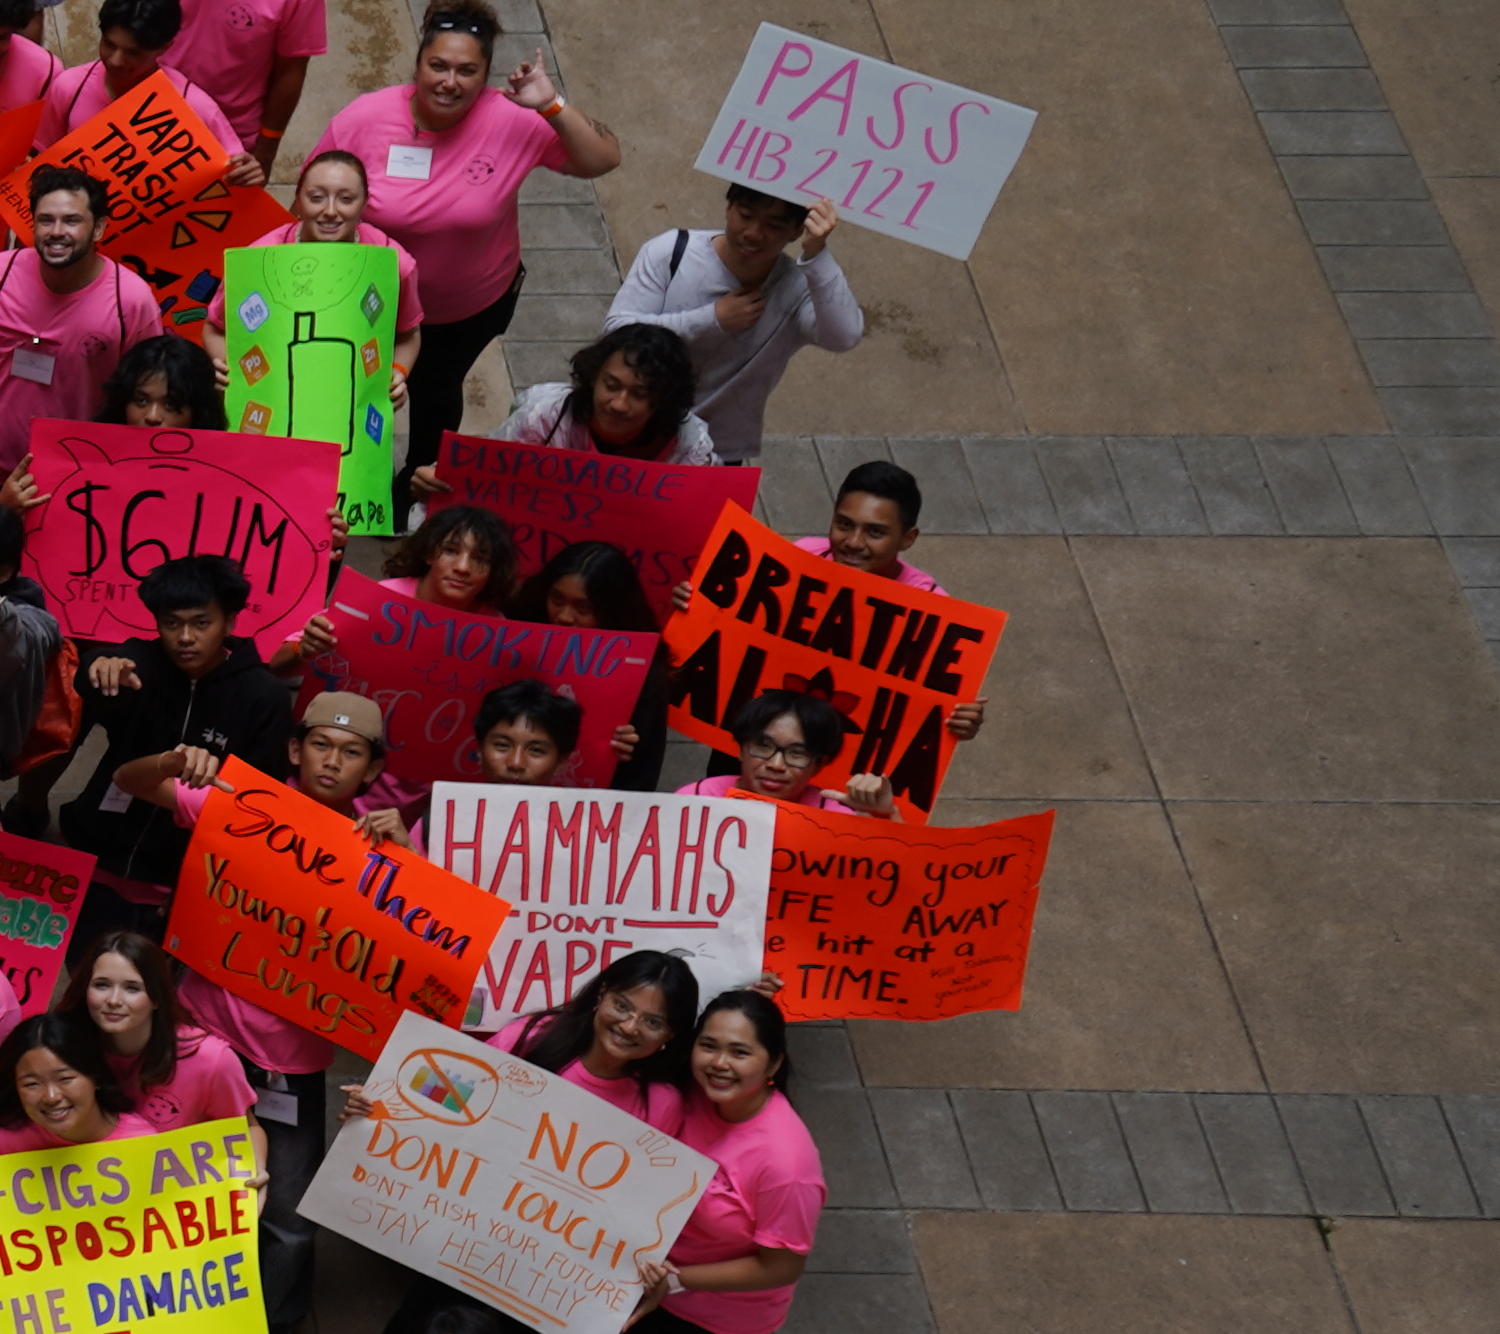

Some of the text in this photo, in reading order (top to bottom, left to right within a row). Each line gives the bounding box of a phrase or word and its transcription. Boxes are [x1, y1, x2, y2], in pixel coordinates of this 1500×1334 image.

[127, 92, 212, 181] VAPE
[756, 40, 992, 165] PASS
[718, 118, 938, 231] HB 2121
[450, 440, 686, 501] DISPOSABLE
[372, 601, 631, 678] SMOKING
[700, 529, 984, 697] BREATHE
[445, 799, 748, 918] HAMMAHS
[924, 853, 1018, 908] your
[527, 911, 616, 935] DONT
[903, 899, 1009, 939] AWAY
[149, 1132, 253, 1195] ARE
[528, 1111, 631, 1192] NO
[367, 1120, 626, 1269] DONT TOUCH
[88, 1251, 249, 1327] DAMAGE
[347, 1196, 587, 1318] STAY HEALTHY
